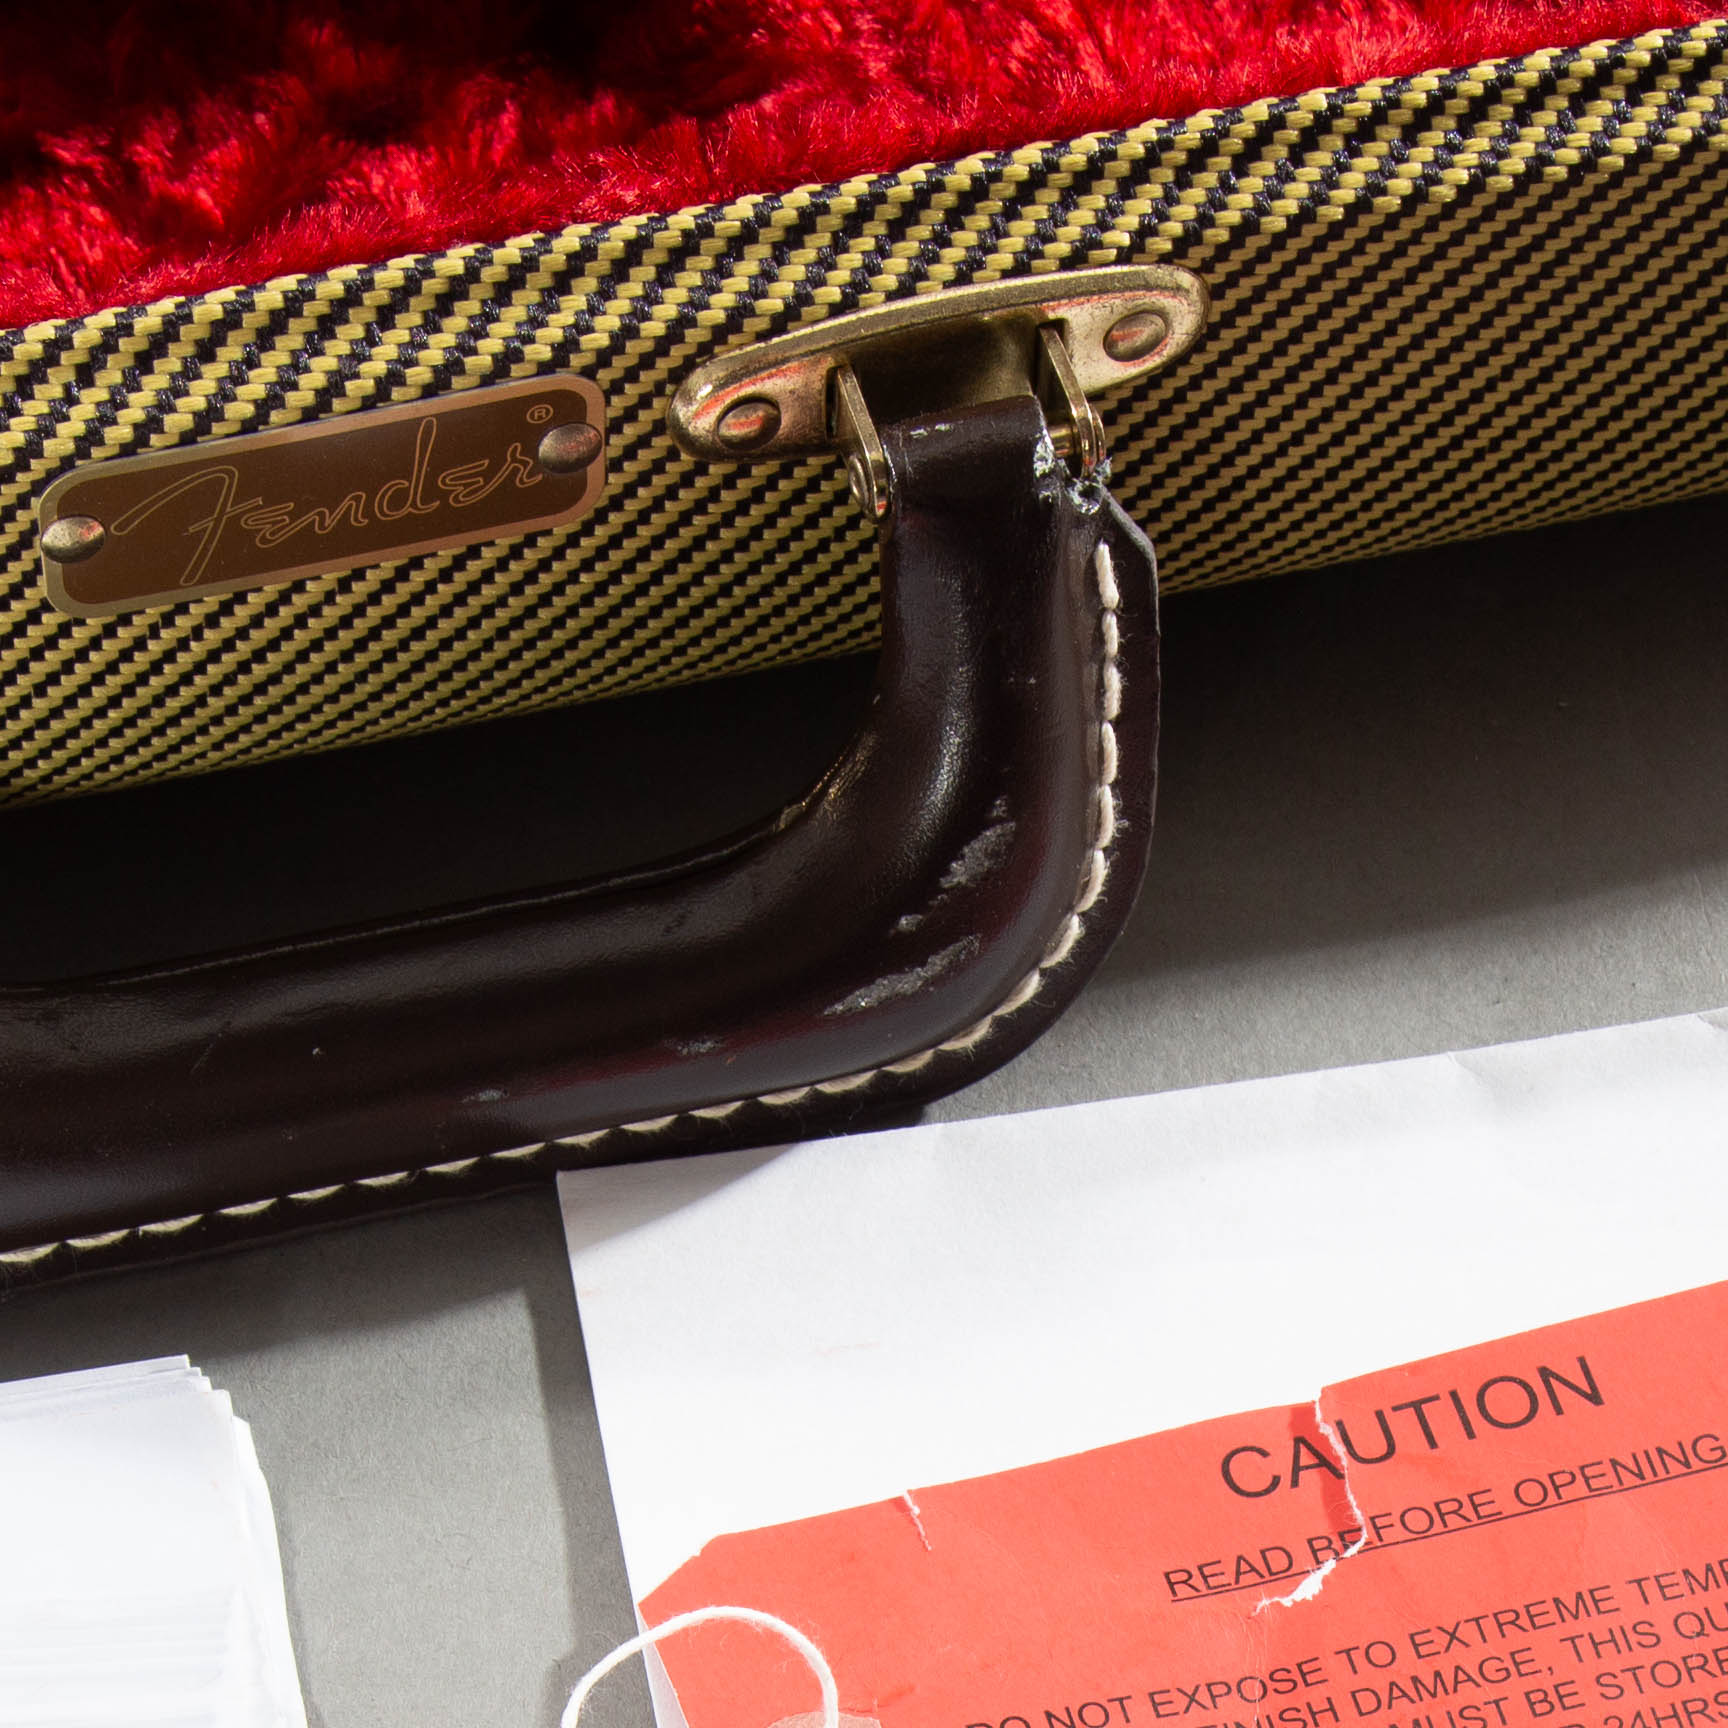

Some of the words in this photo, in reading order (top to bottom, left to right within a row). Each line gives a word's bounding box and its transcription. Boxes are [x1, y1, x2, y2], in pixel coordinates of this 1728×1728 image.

[111, 417, 543, 585] Fender
[1221, 1355, 1605, 1498] CAUTION
[1163, 1545, 1293, 1599] READ
[1306, 1487, 1504, 1568] BEFORE
[1514, 1432, 1728, 1510] OPENING
[1149, 1658, 1328, 1719] EXPOSE
[1336, 1640, 1397, 1675] TO
[1410, 1585, 1619, 1659] EXTREME
[1351, 1647, 1553, 1717] DAMAGE,
[1561, 1620, 1661, 1663] THIS
[1526, 1689, 1584, 1719] BE
